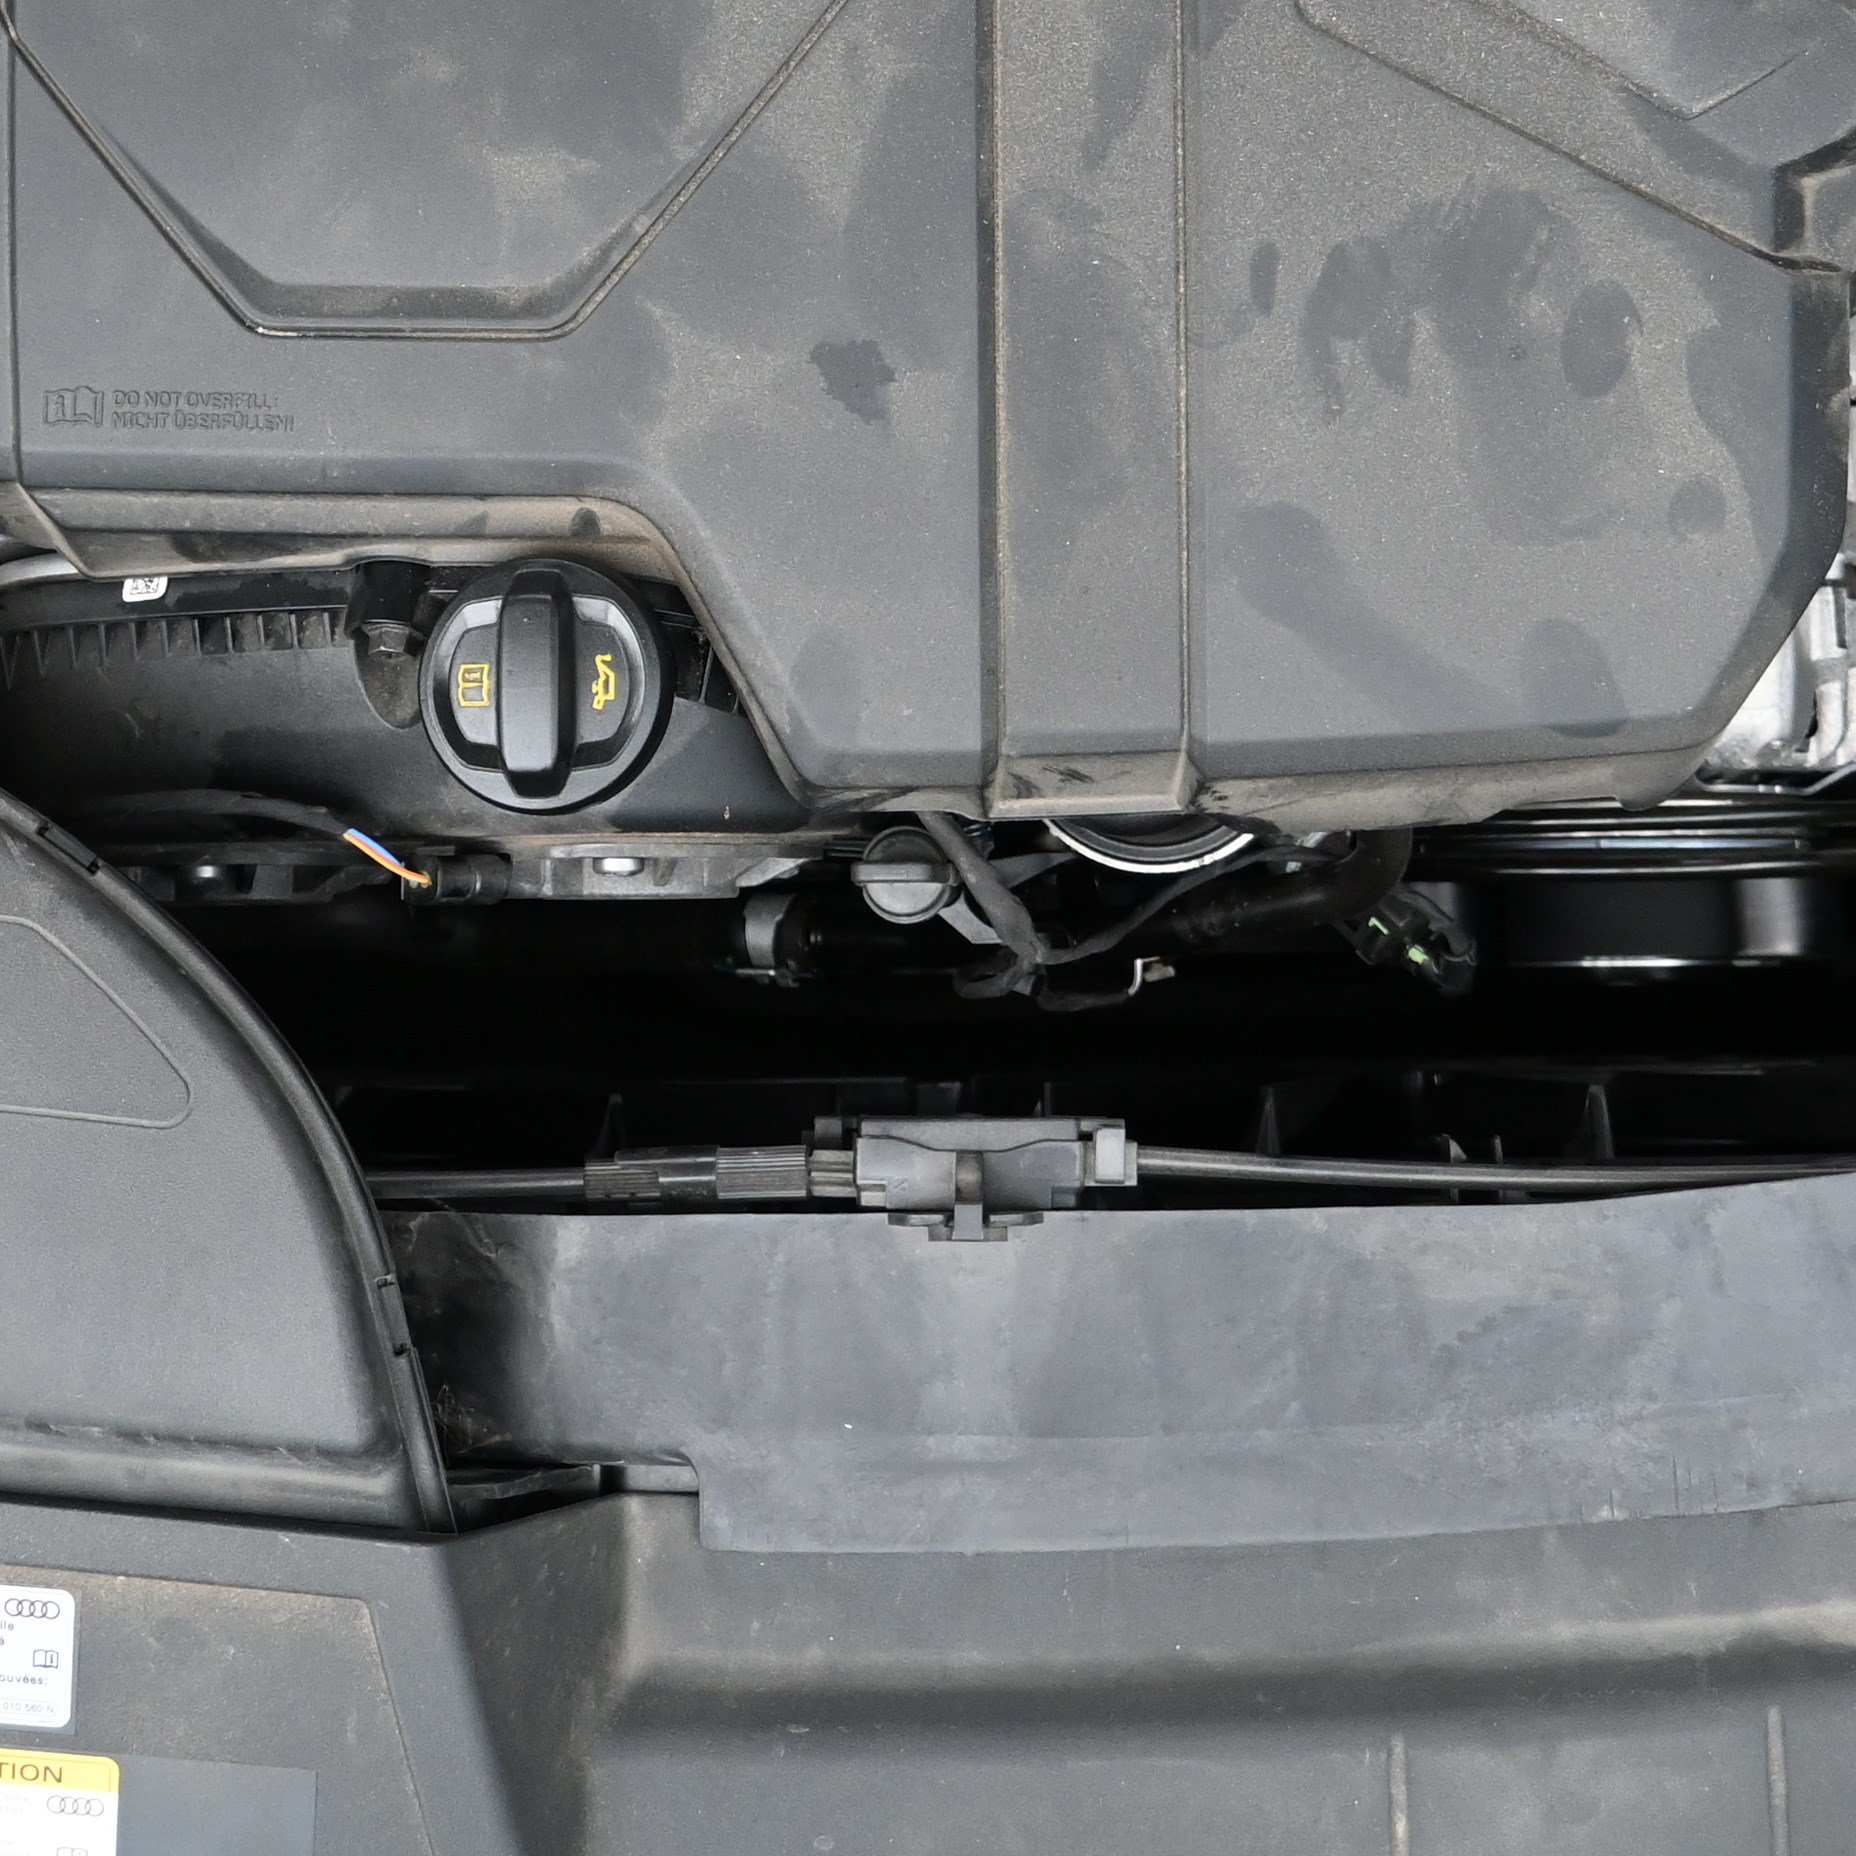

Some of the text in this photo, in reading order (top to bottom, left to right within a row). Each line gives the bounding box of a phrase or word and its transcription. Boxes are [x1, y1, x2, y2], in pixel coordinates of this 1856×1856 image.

[113, 390, 140, 408] DO
[146, 391, 183, 408] NOT
[113, 411, 170, 430] NICHT
[2, 1701, 21, 1711] 010
[25, 1702, 43, 1713] 560
